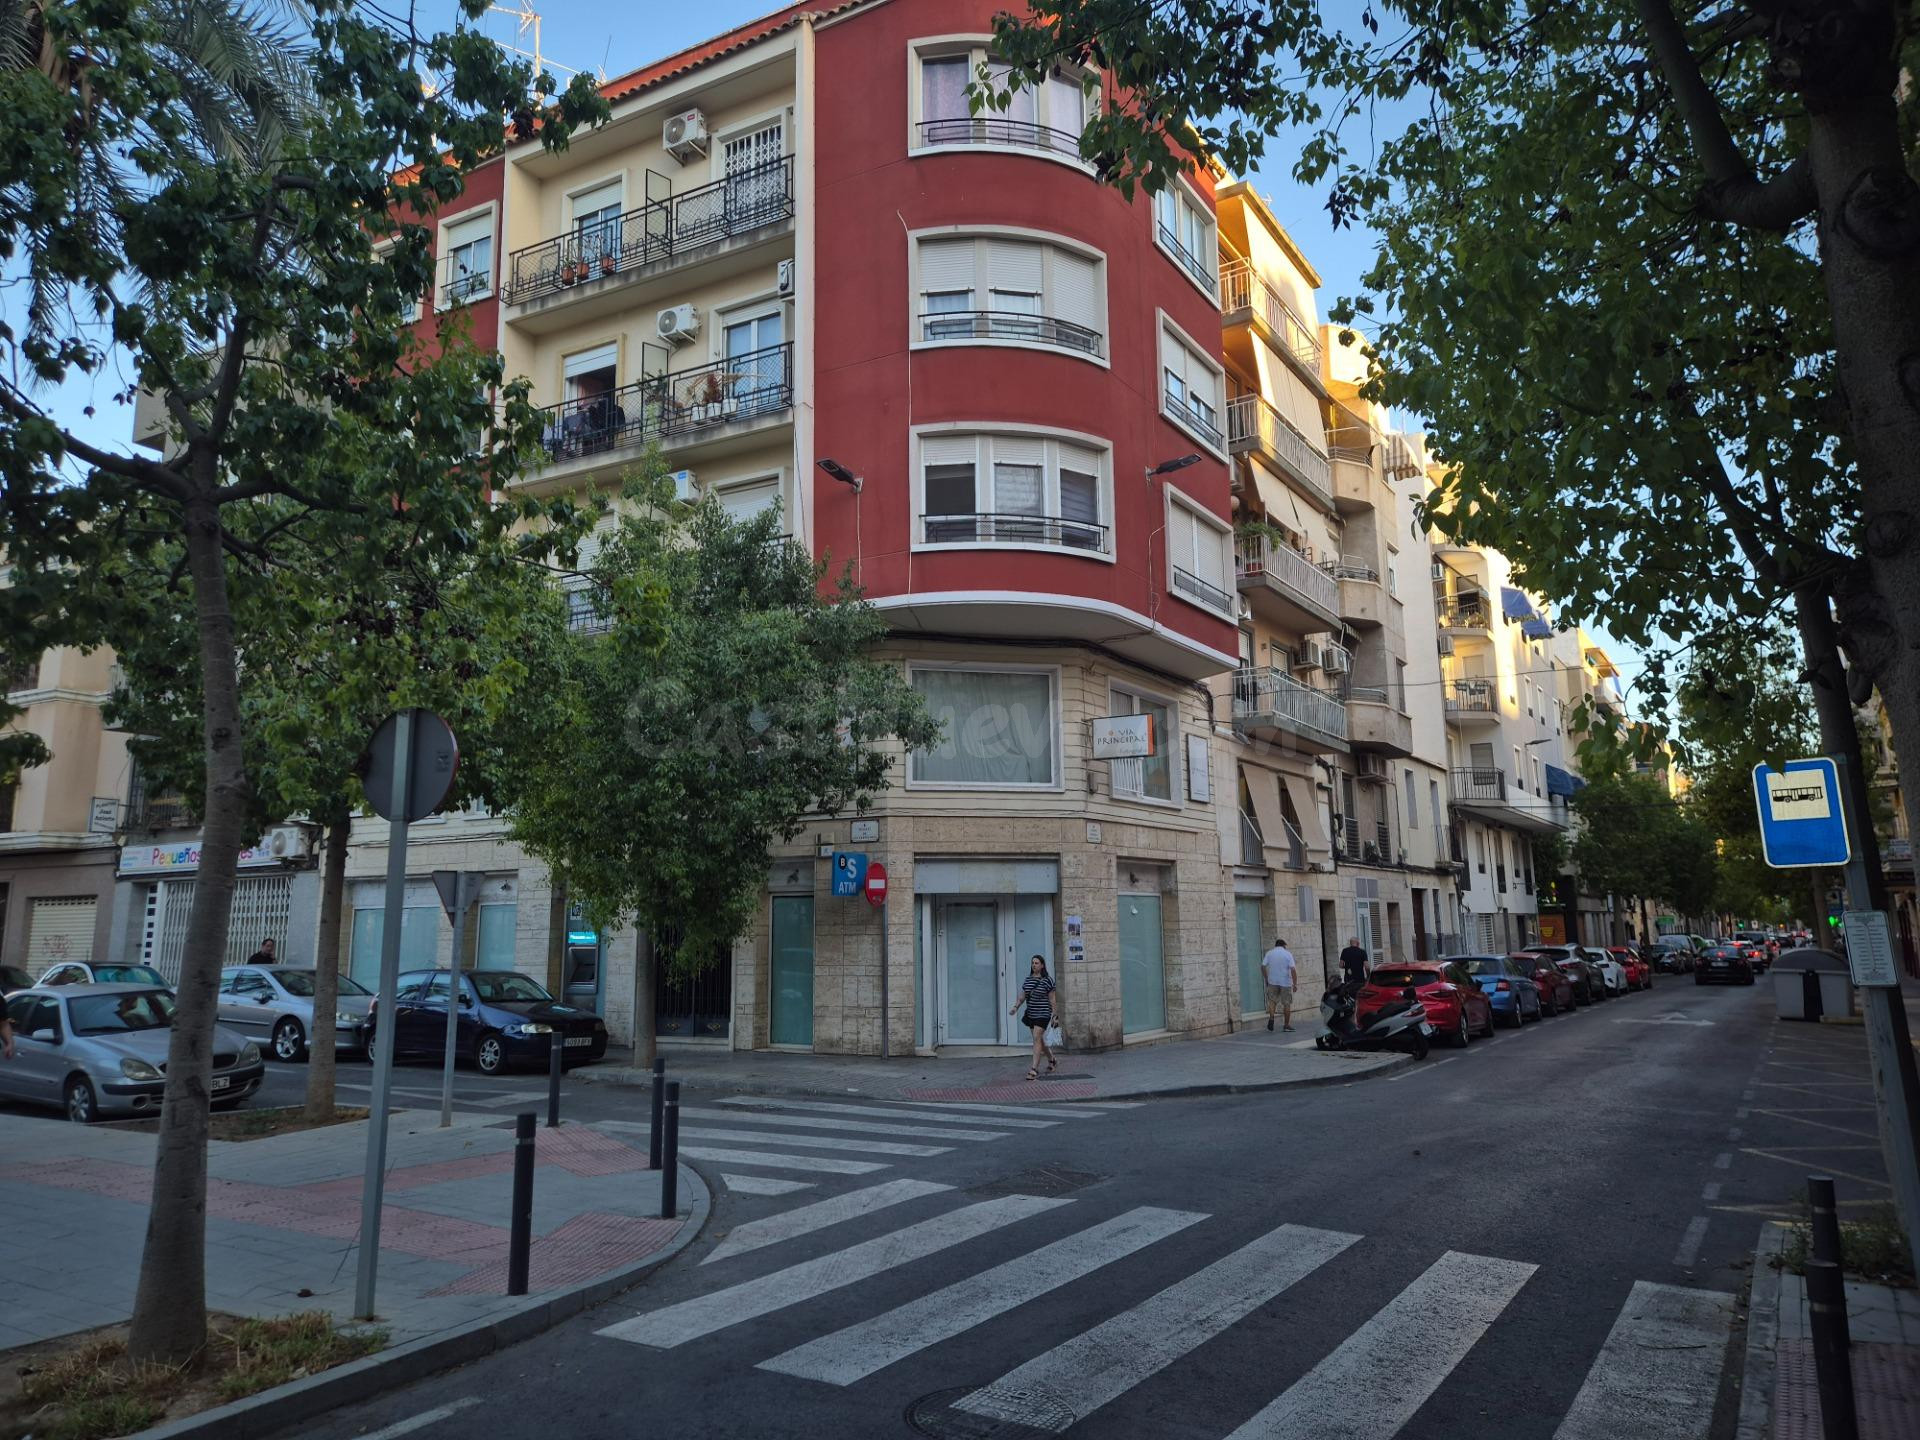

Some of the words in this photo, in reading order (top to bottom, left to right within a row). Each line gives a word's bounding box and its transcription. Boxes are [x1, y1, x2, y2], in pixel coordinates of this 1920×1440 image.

[1097, 734, 1146, 744] PRINCIPAL
[151, 847, 201, 865] Pequeños
[838, 881, 856, 894] ATM
